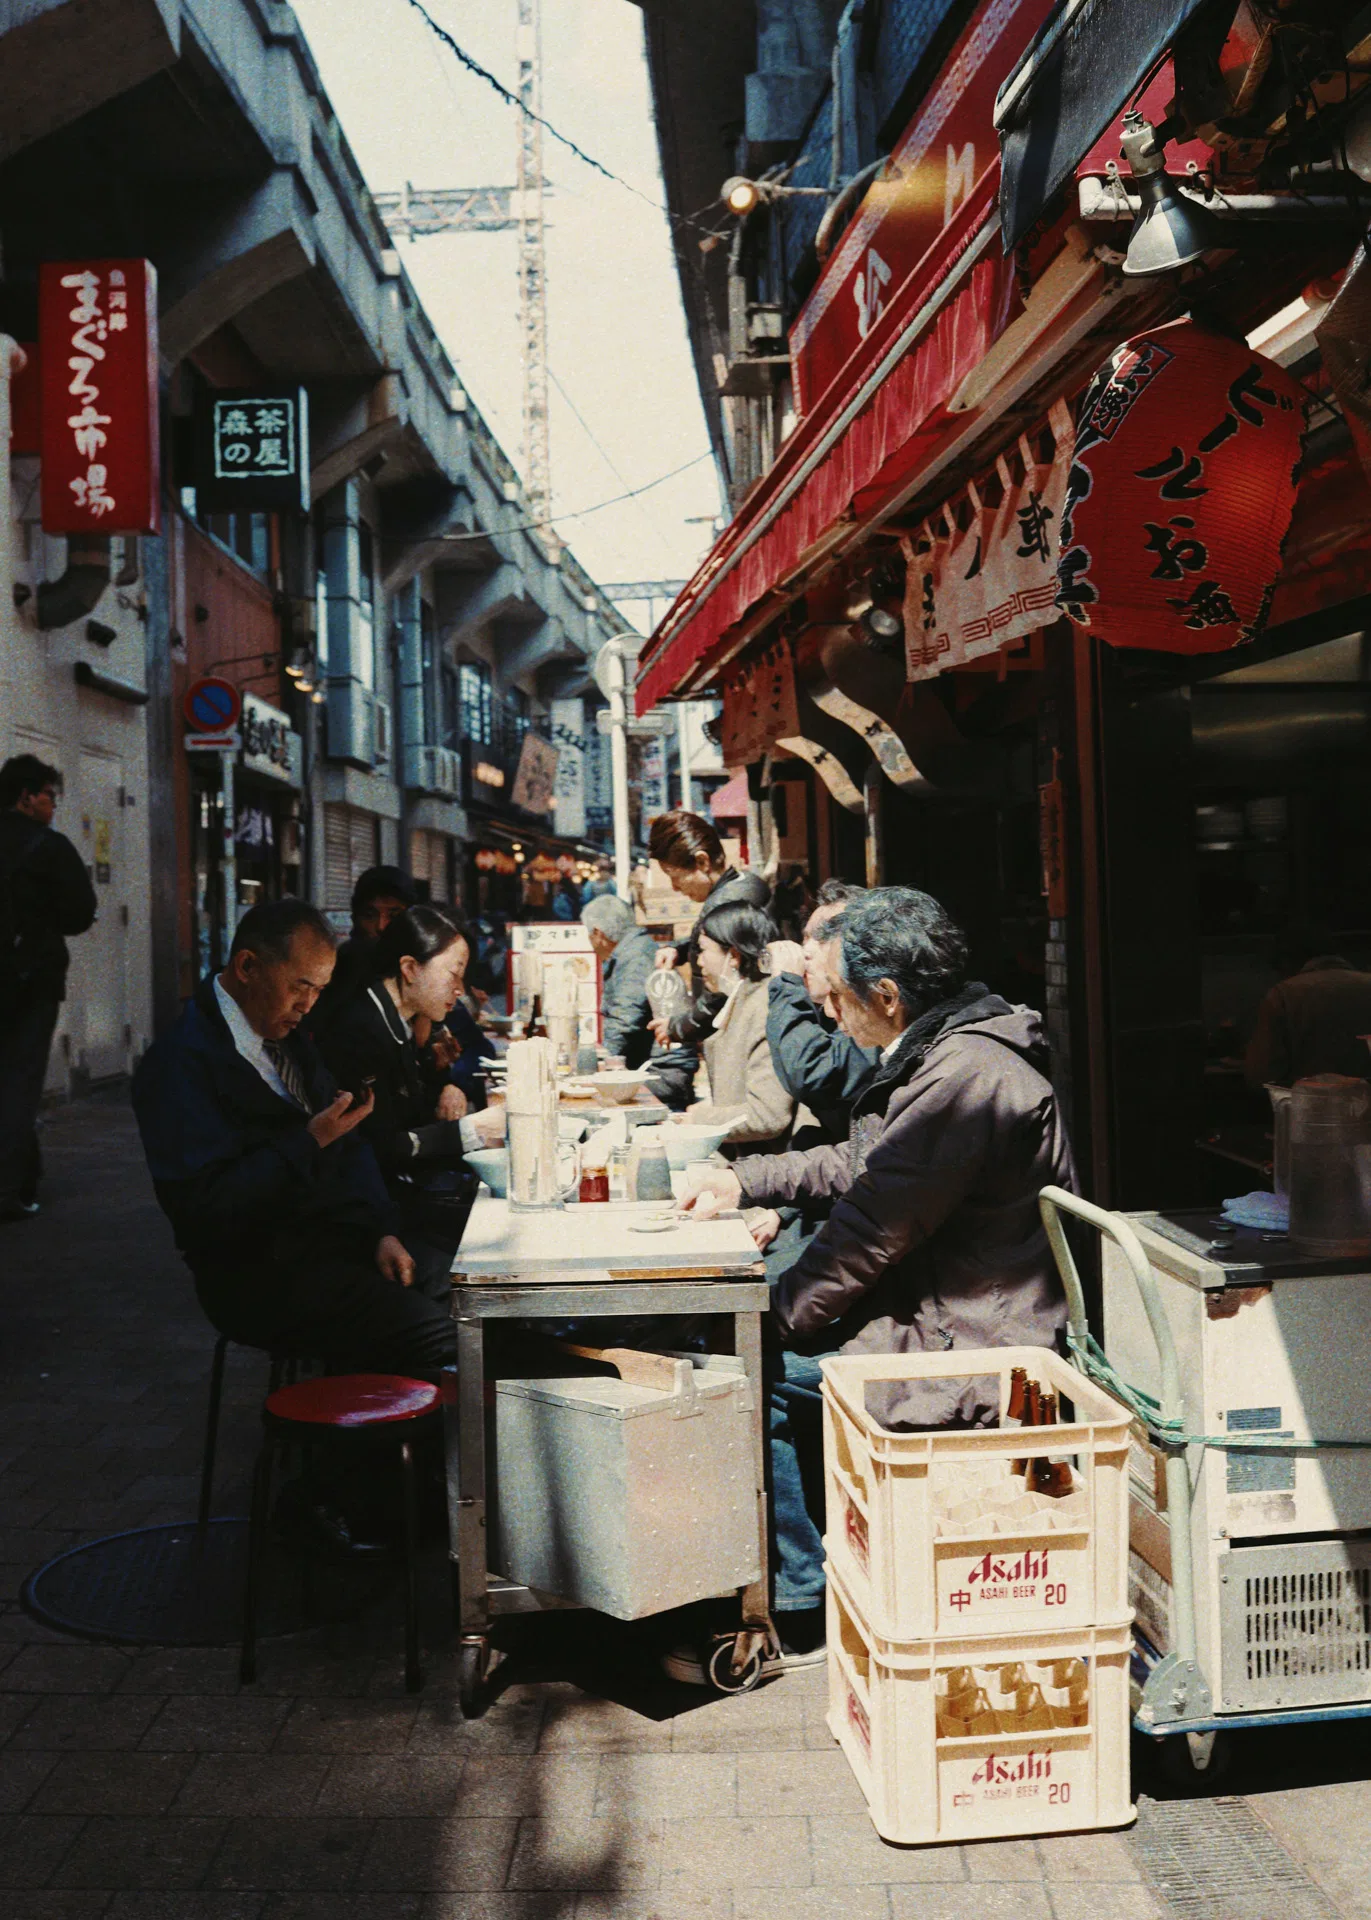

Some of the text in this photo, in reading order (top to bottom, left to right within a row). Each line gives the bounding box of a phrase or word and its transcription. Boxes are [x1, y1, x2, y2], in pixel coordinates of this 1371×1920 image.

[61, 270, 116, 518] まぐろ市場
[221, 409, 254, 464] 森の
[253, 408, 288, 467] 茶屋
[967, 1548, 1049, 1584] Asahi
[950, 1583, 1066, 1612] 中 ASAHI BEER 20
[971, 1748, 1052, 1785] Asahi
[1016, 1785, 1039, 1798] BEER
[1049, 1783, 1070, 1804] 20
